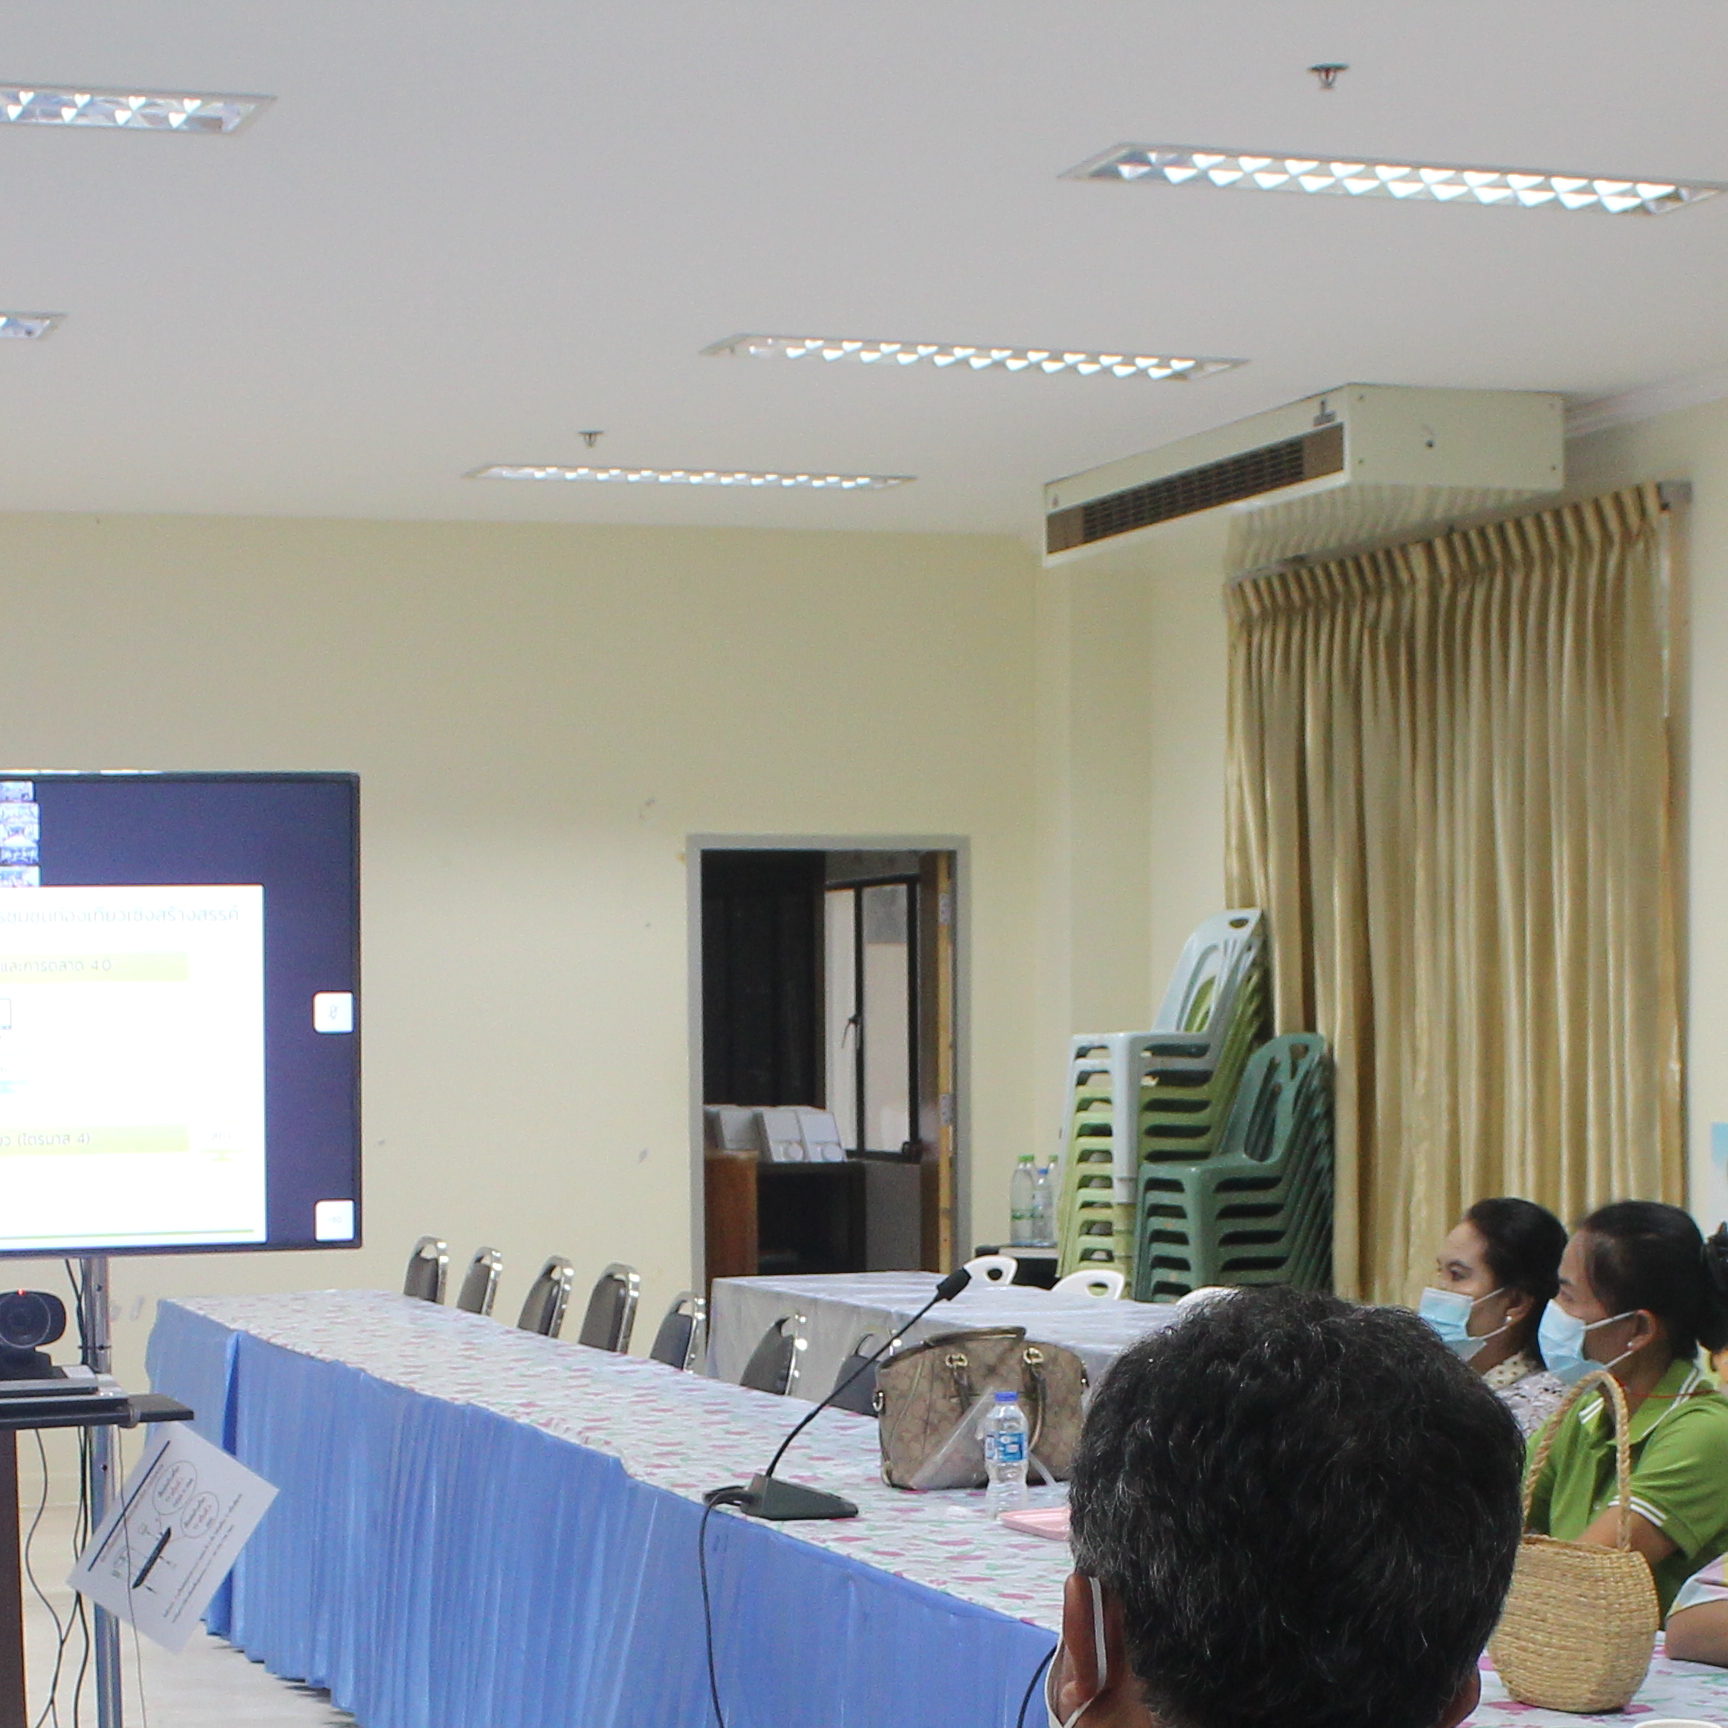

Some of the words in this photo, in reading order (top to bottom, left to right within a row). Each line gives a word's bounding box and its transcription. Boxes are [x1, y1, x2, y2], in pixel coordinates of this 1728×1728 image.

[18, 1132, 71, 1149] (ไตรมาส
[76, 1132, 91, 1147] 4)
